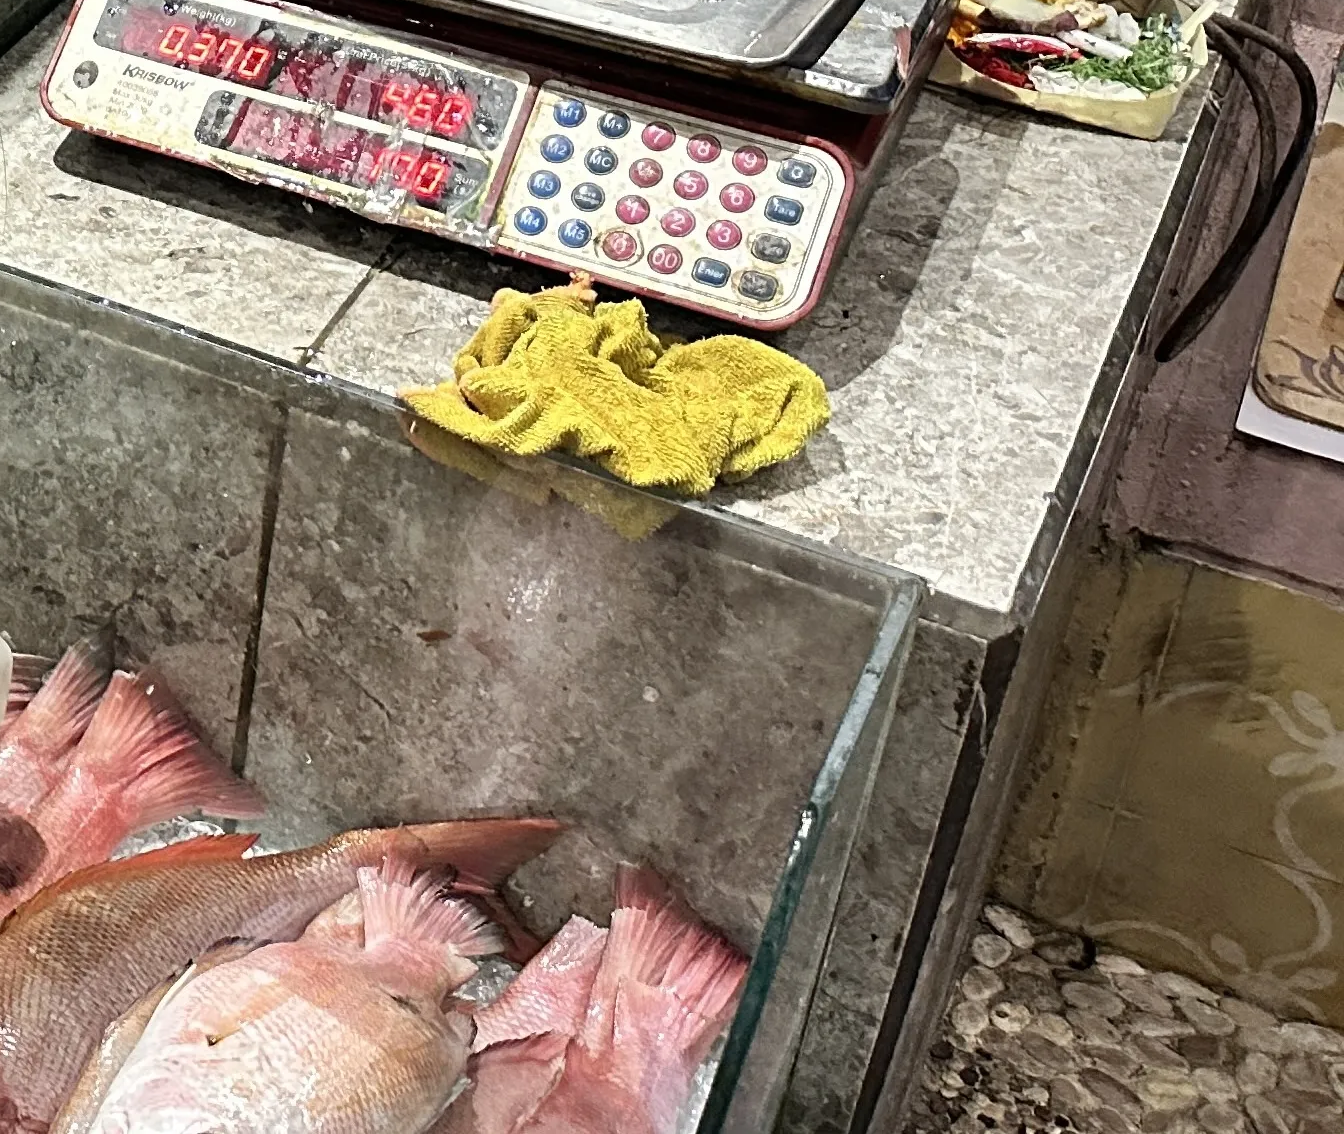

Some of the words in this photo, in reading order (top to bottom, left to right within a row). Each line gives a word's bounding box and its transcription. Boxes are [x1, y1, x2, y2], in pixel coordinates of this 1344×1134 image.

[159, 26, 269, 78] 0.370
[123, 64, 190, 91] KRISBOW
[560, 105, 580, 120] M1
[653, 128, 666, 144] 7
[546, 142, 568, 156] M2
[699, 139, 710, 155] 8
[589, 153, 611, 167] MC
[746, 151, 757, 169] 9
[534, 175, 553, 191] M3
[686, 176, 698, 192] 5
[520, 214, 540, 227] M4
[671, 213, 684, 231] 2
[564, 226, 586, 241] M5
[718, 227, 730, 242] 3
[654, 248, 678, 268] 00
